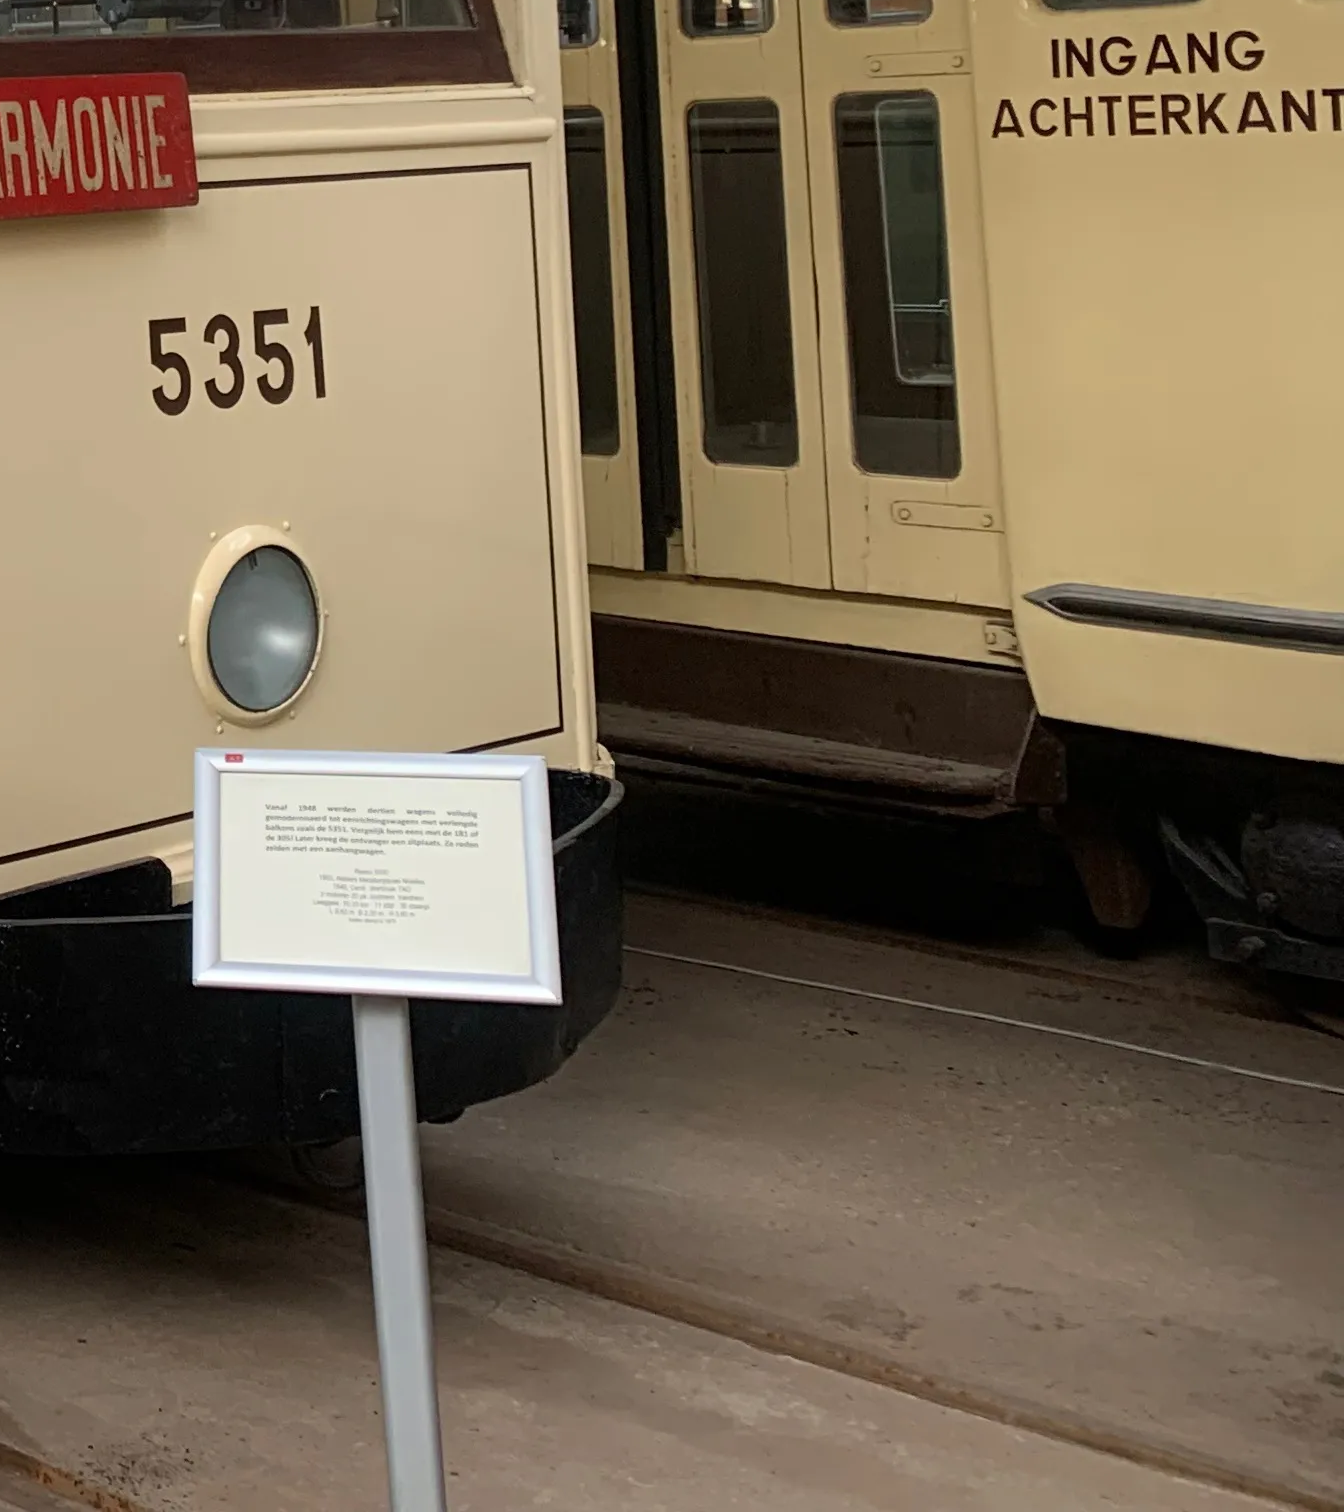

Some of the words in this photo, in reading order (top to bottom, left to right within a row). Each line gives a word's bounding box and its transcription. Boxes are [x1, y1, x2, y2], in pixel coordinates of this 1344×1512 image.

[1051, 30, 1265, 79] INGANG
[991, 88, 1344, 139] ACHTERKANT
[148, 305, 326, 417] 5351
